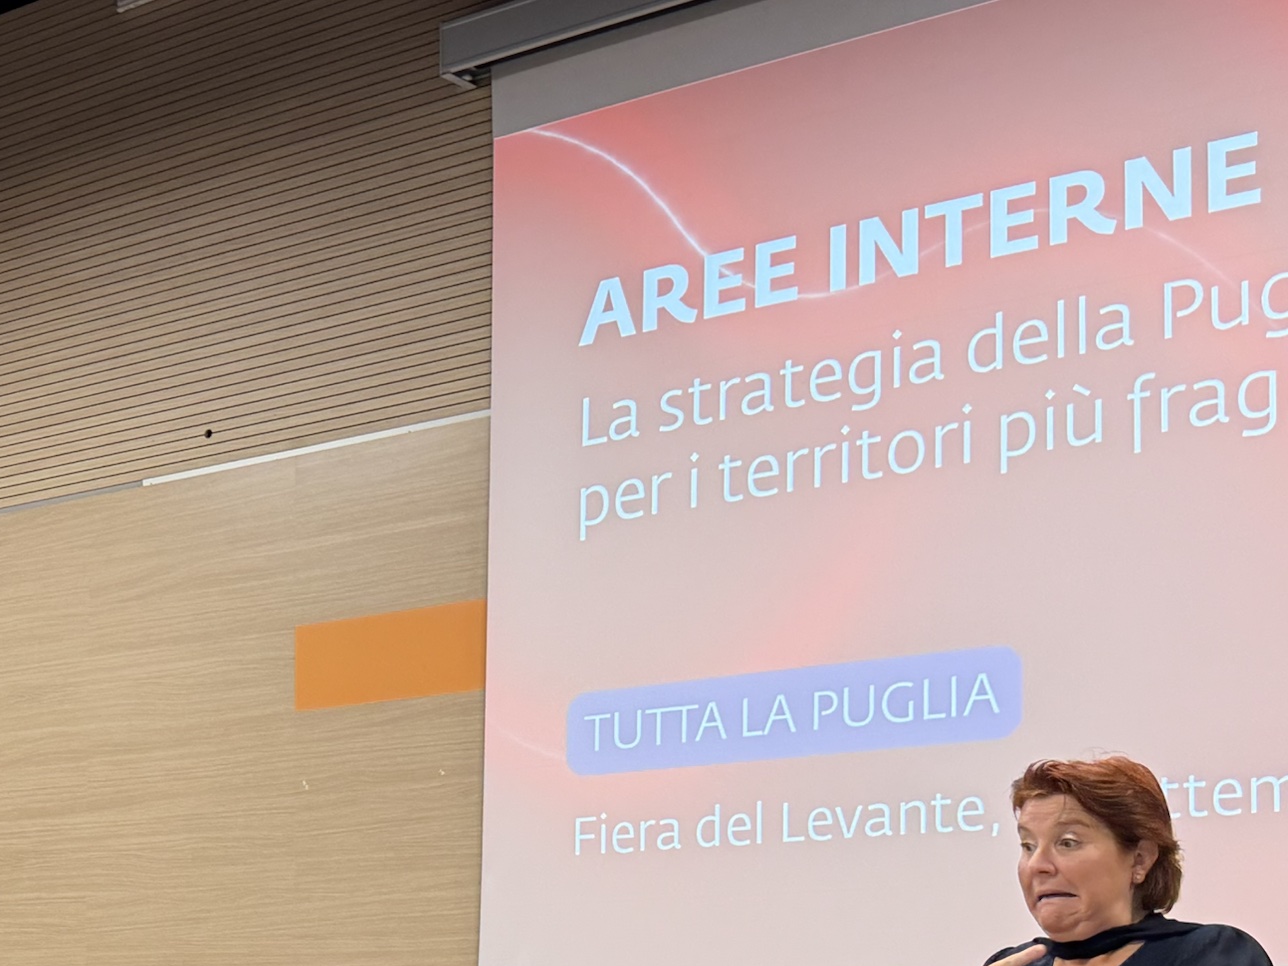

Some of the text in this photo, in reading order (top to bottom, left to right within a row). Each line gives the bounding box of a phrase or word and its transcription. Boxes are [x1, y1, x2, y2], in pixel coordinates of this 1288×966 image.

[579, 130, 1263, 347] AREE INTERNE
[580, 271, 1288, 448] La strategia della Pug
[578, 369, 1278, 542] per i territori più frag
[583, 672, 1001, 753] TUTTA LA PUGLIA
[573, 815, 681, 856] Fiera
[694, 799, 763, 849] del
[782, 792, 1001, 845] Levante,
